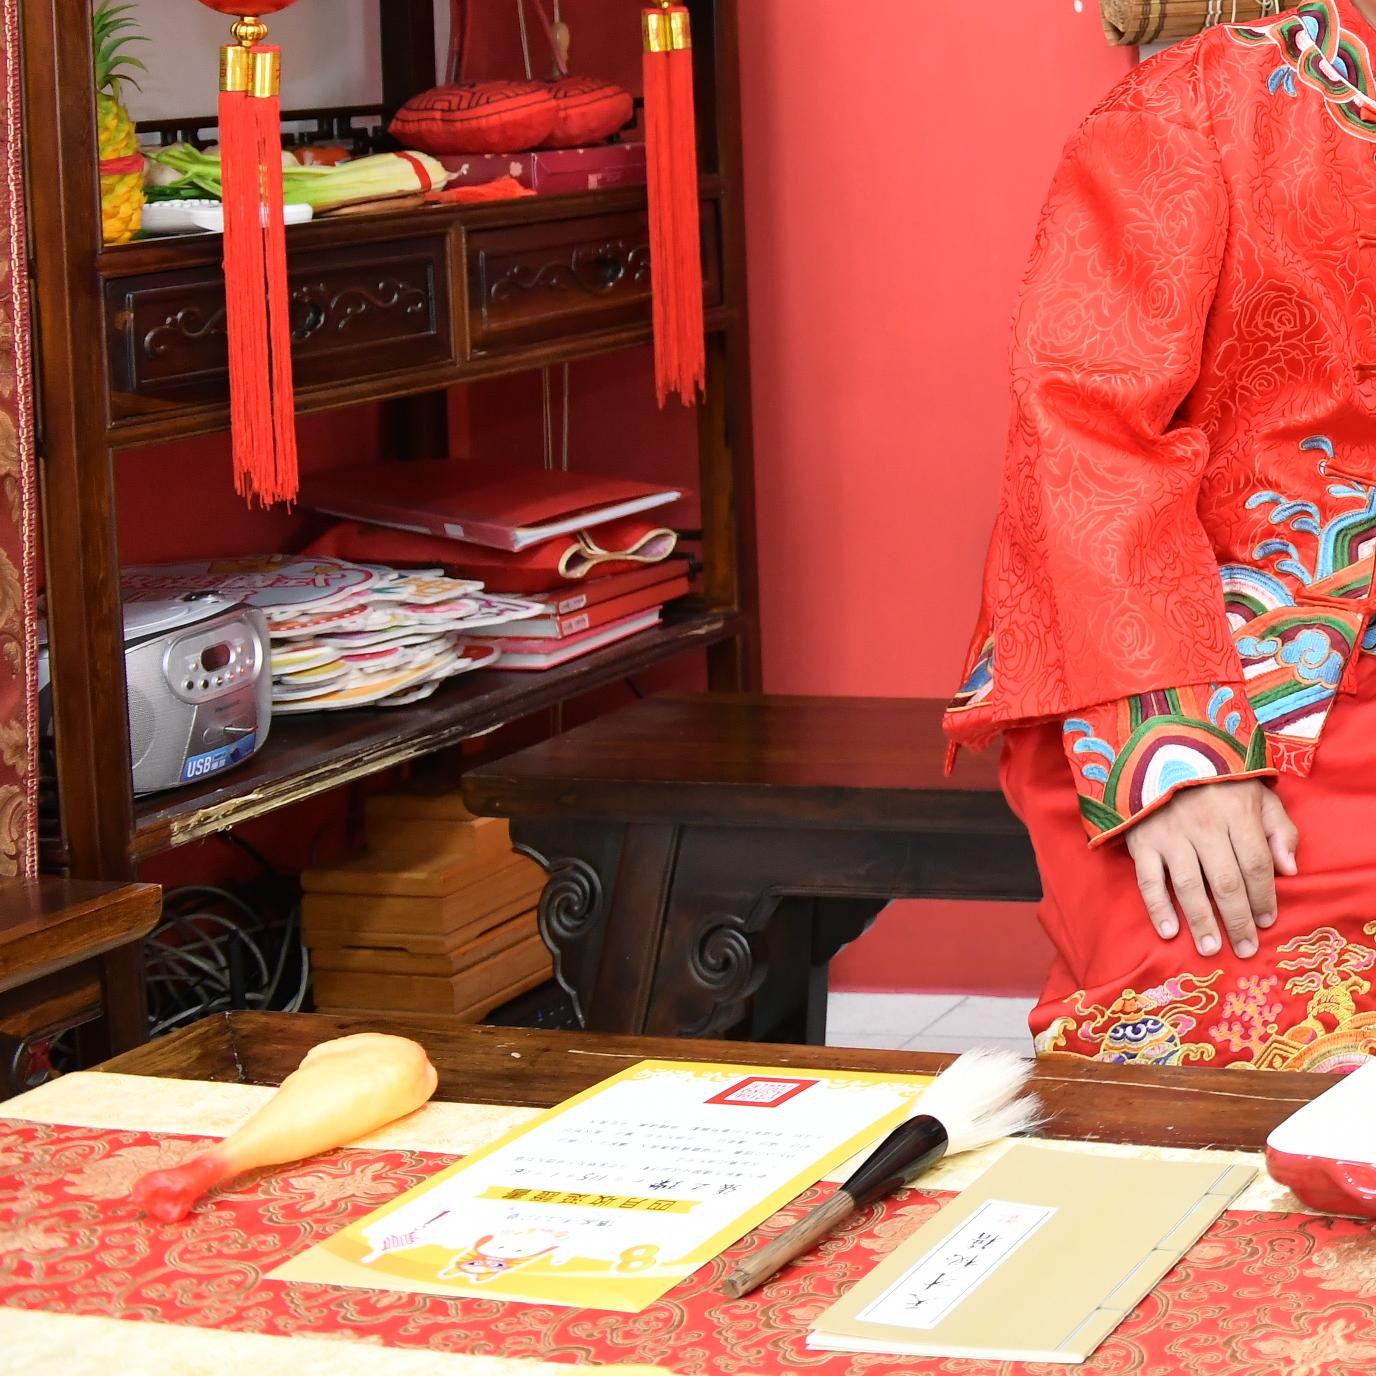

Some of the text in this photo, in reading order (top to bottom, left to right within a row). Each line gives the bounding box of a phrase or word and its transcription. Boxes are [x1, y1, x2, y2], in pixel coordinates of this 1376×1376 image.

[187, 756, 212, 778] USB
[502, 1189, 677, 1211] 四月收涎證書
